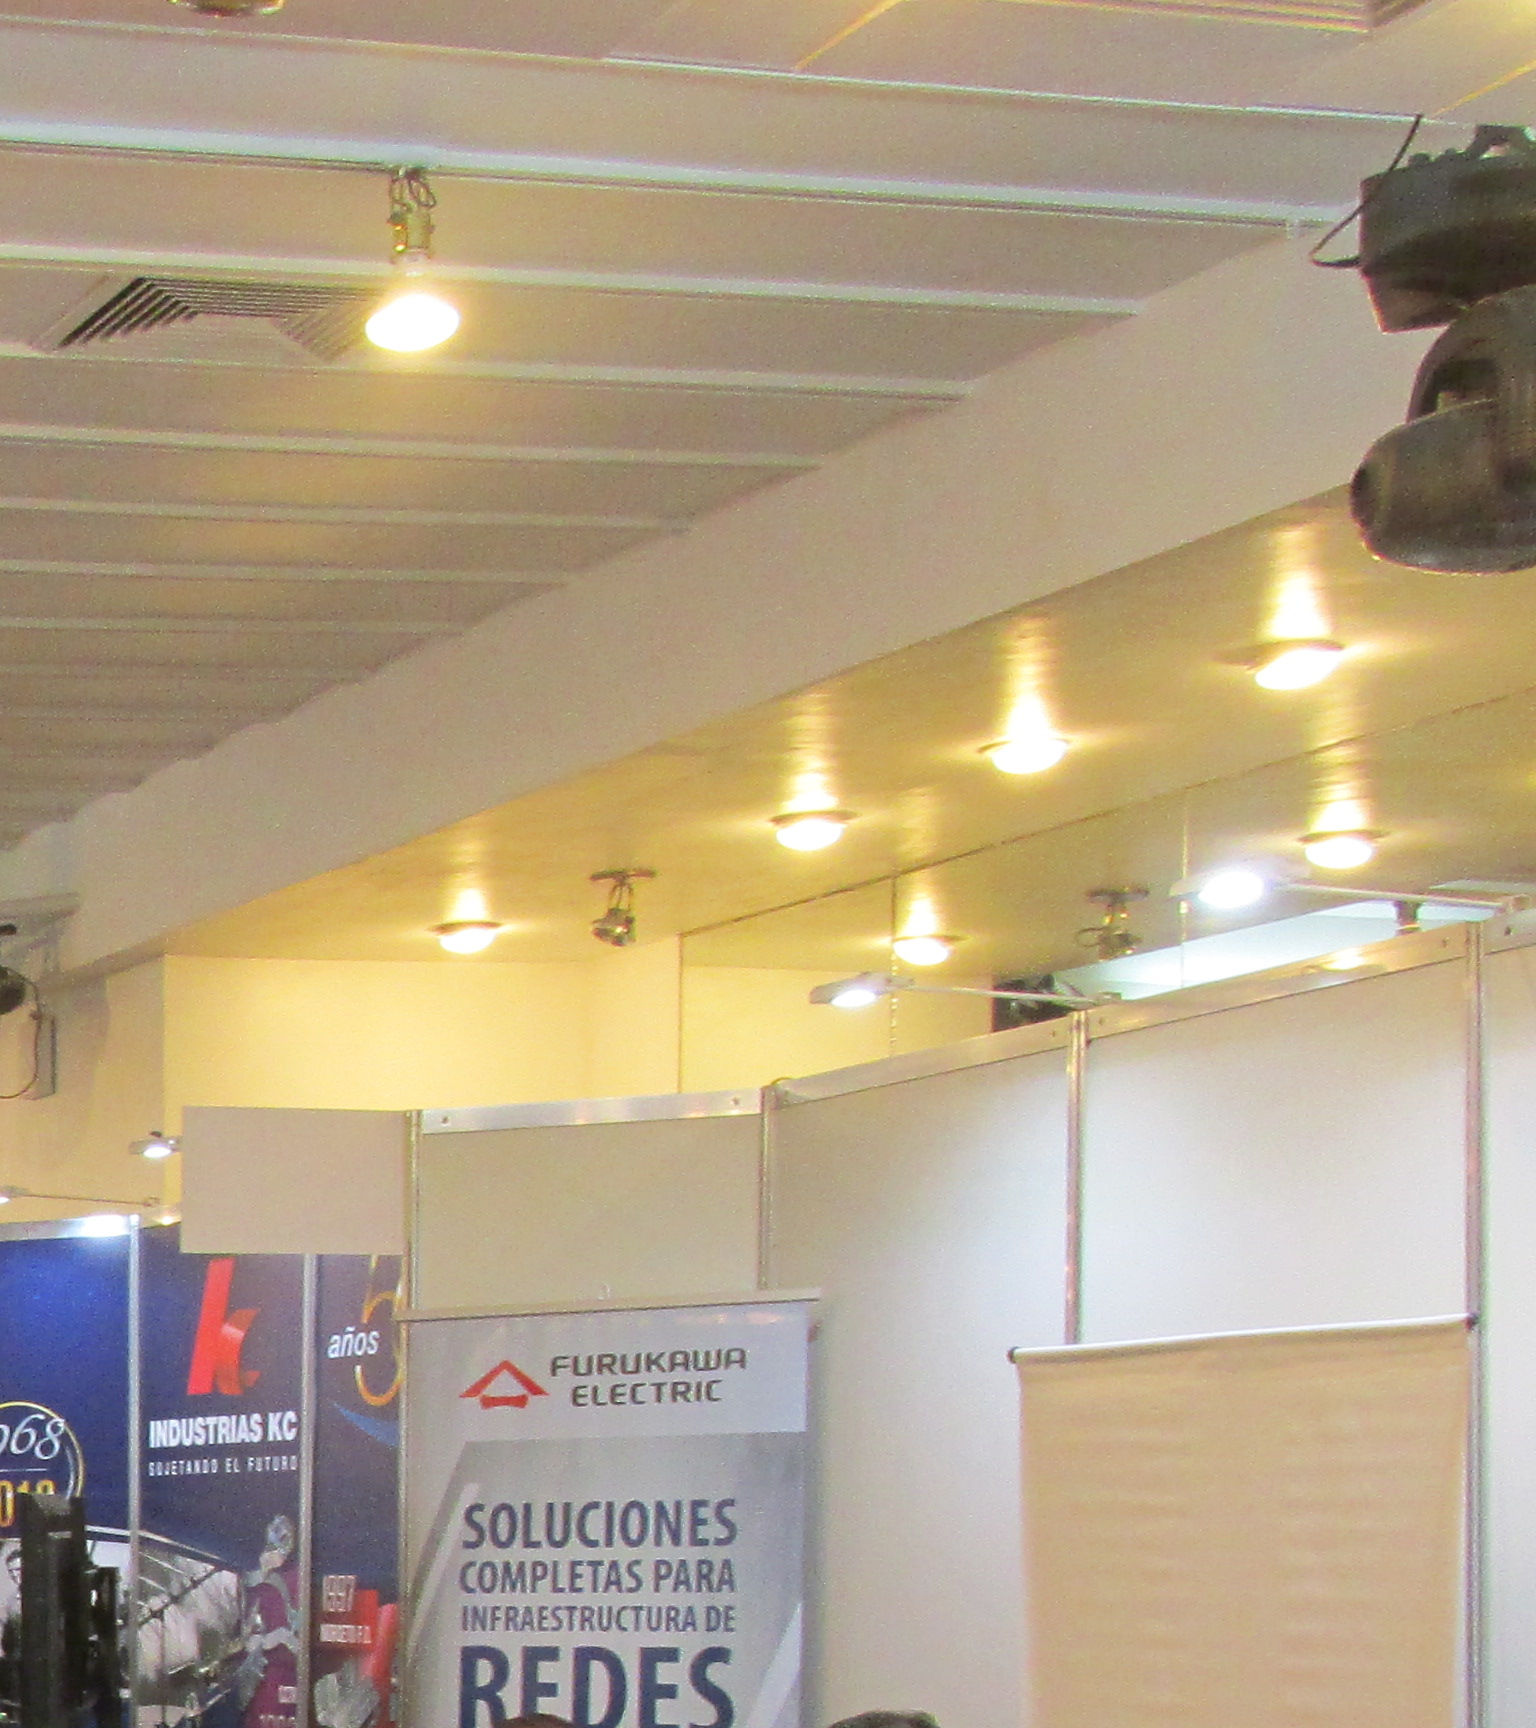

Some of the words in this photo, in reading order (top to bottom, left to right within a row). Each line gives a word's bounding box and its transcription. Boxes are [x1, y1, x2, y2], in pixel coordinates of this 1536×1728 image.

[328, 1326, 379, 1359] años
[550, 1347, 748, 1378] FURUKAWA
[571, 1379, 724, 1408] ELECTRIC
[148, 1413, 263, 1449] INDUSTRIAS
[268, 1410, 299, 1442] KC
[462, 1498, 739, 1550] SOLUCIONES
[459, 1558, 644, 1595] COMPLETAS
[653, 1558, 737, 1594] PARA
[462, 1604, 697, 1634] INFRAESTRUCTURA
[705, 1605, 736, 1634] DE
